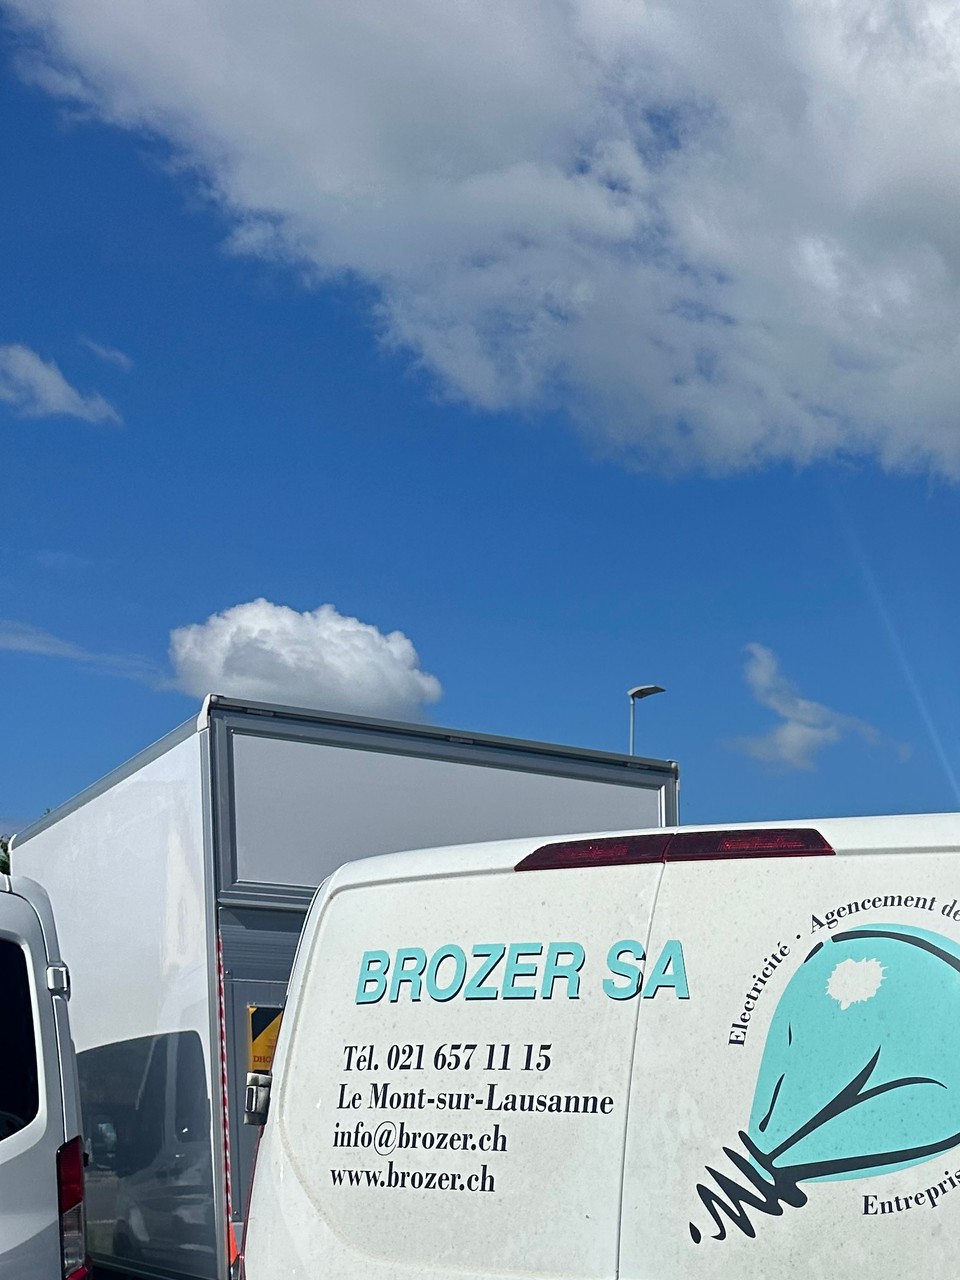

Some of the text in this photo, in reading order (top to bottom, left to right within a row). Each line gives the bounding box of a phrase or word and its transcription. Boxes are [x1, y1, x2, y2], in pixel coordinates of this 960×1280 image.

[355, 939, 690, 1005] BROZER SA
[728, 942, 791, 1047] Electricité
[809, 895, 937, 934] Agencement
[343, 1043, 553, 1071] Tél. 021 657 11 15
[336, 1083, 614, 1114] Le Mont-sur-Lausanne
[332, 1120, 508, 1156] info@brozer.ch
[330, 1161, 496, 1193] www.brozer.ch
